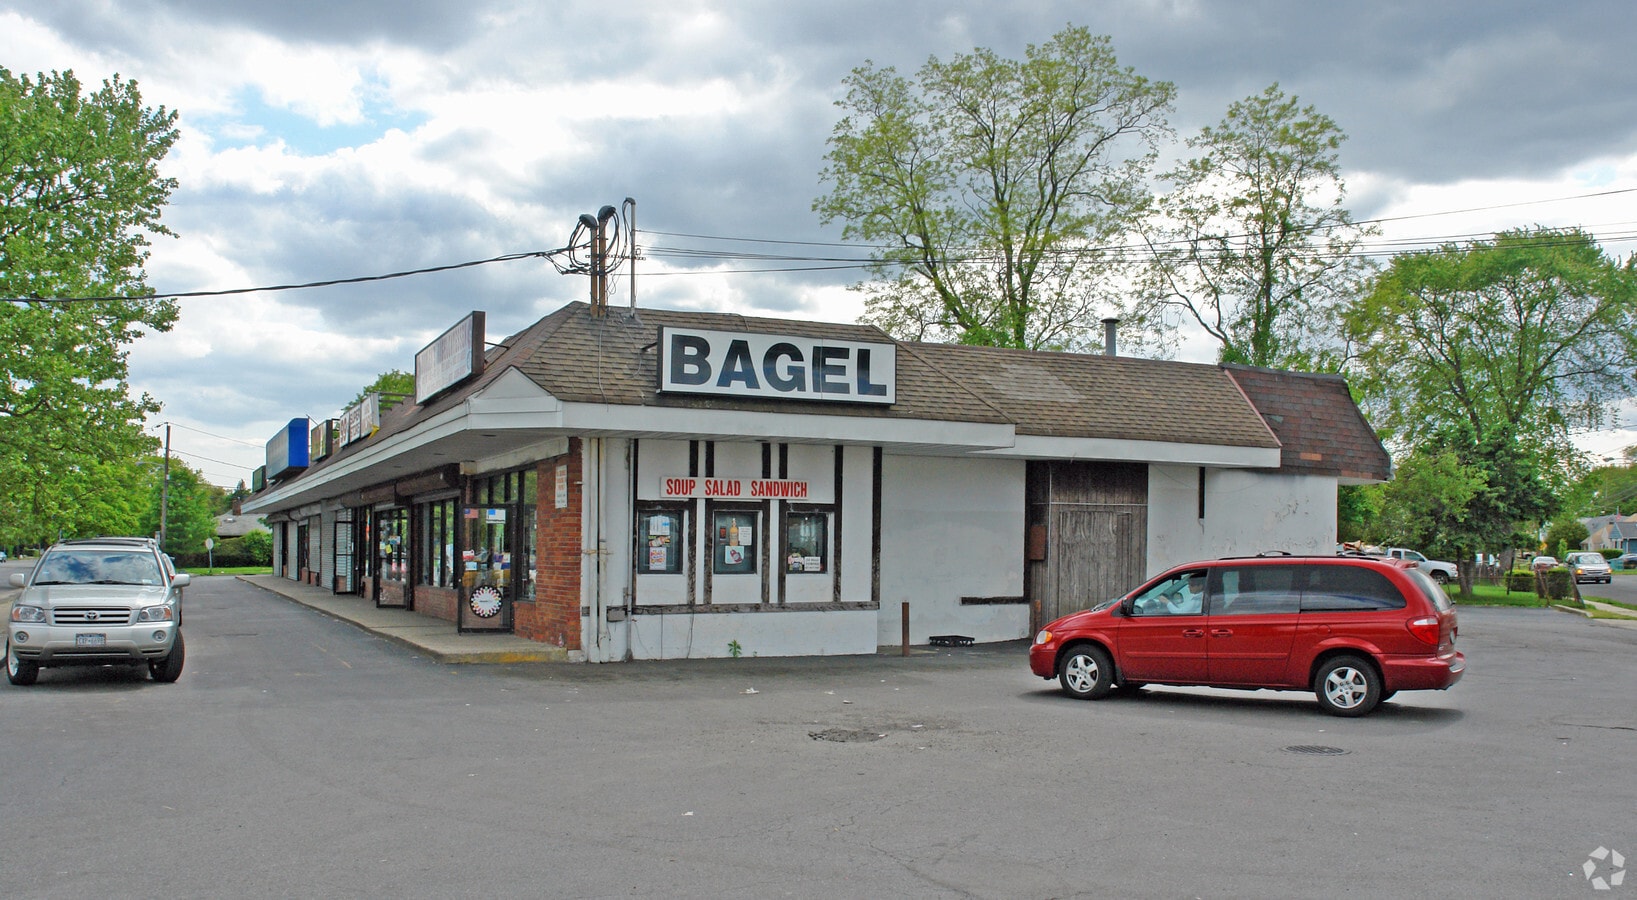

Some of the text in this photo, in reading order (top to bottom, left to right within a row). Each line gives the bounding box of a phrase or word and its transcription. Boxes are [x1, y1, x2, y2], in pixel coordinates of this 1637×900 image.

[670, 334, 887, 396] BAGEL
[666, 478, 807, 497] SOUP SALAD SANDWICH
